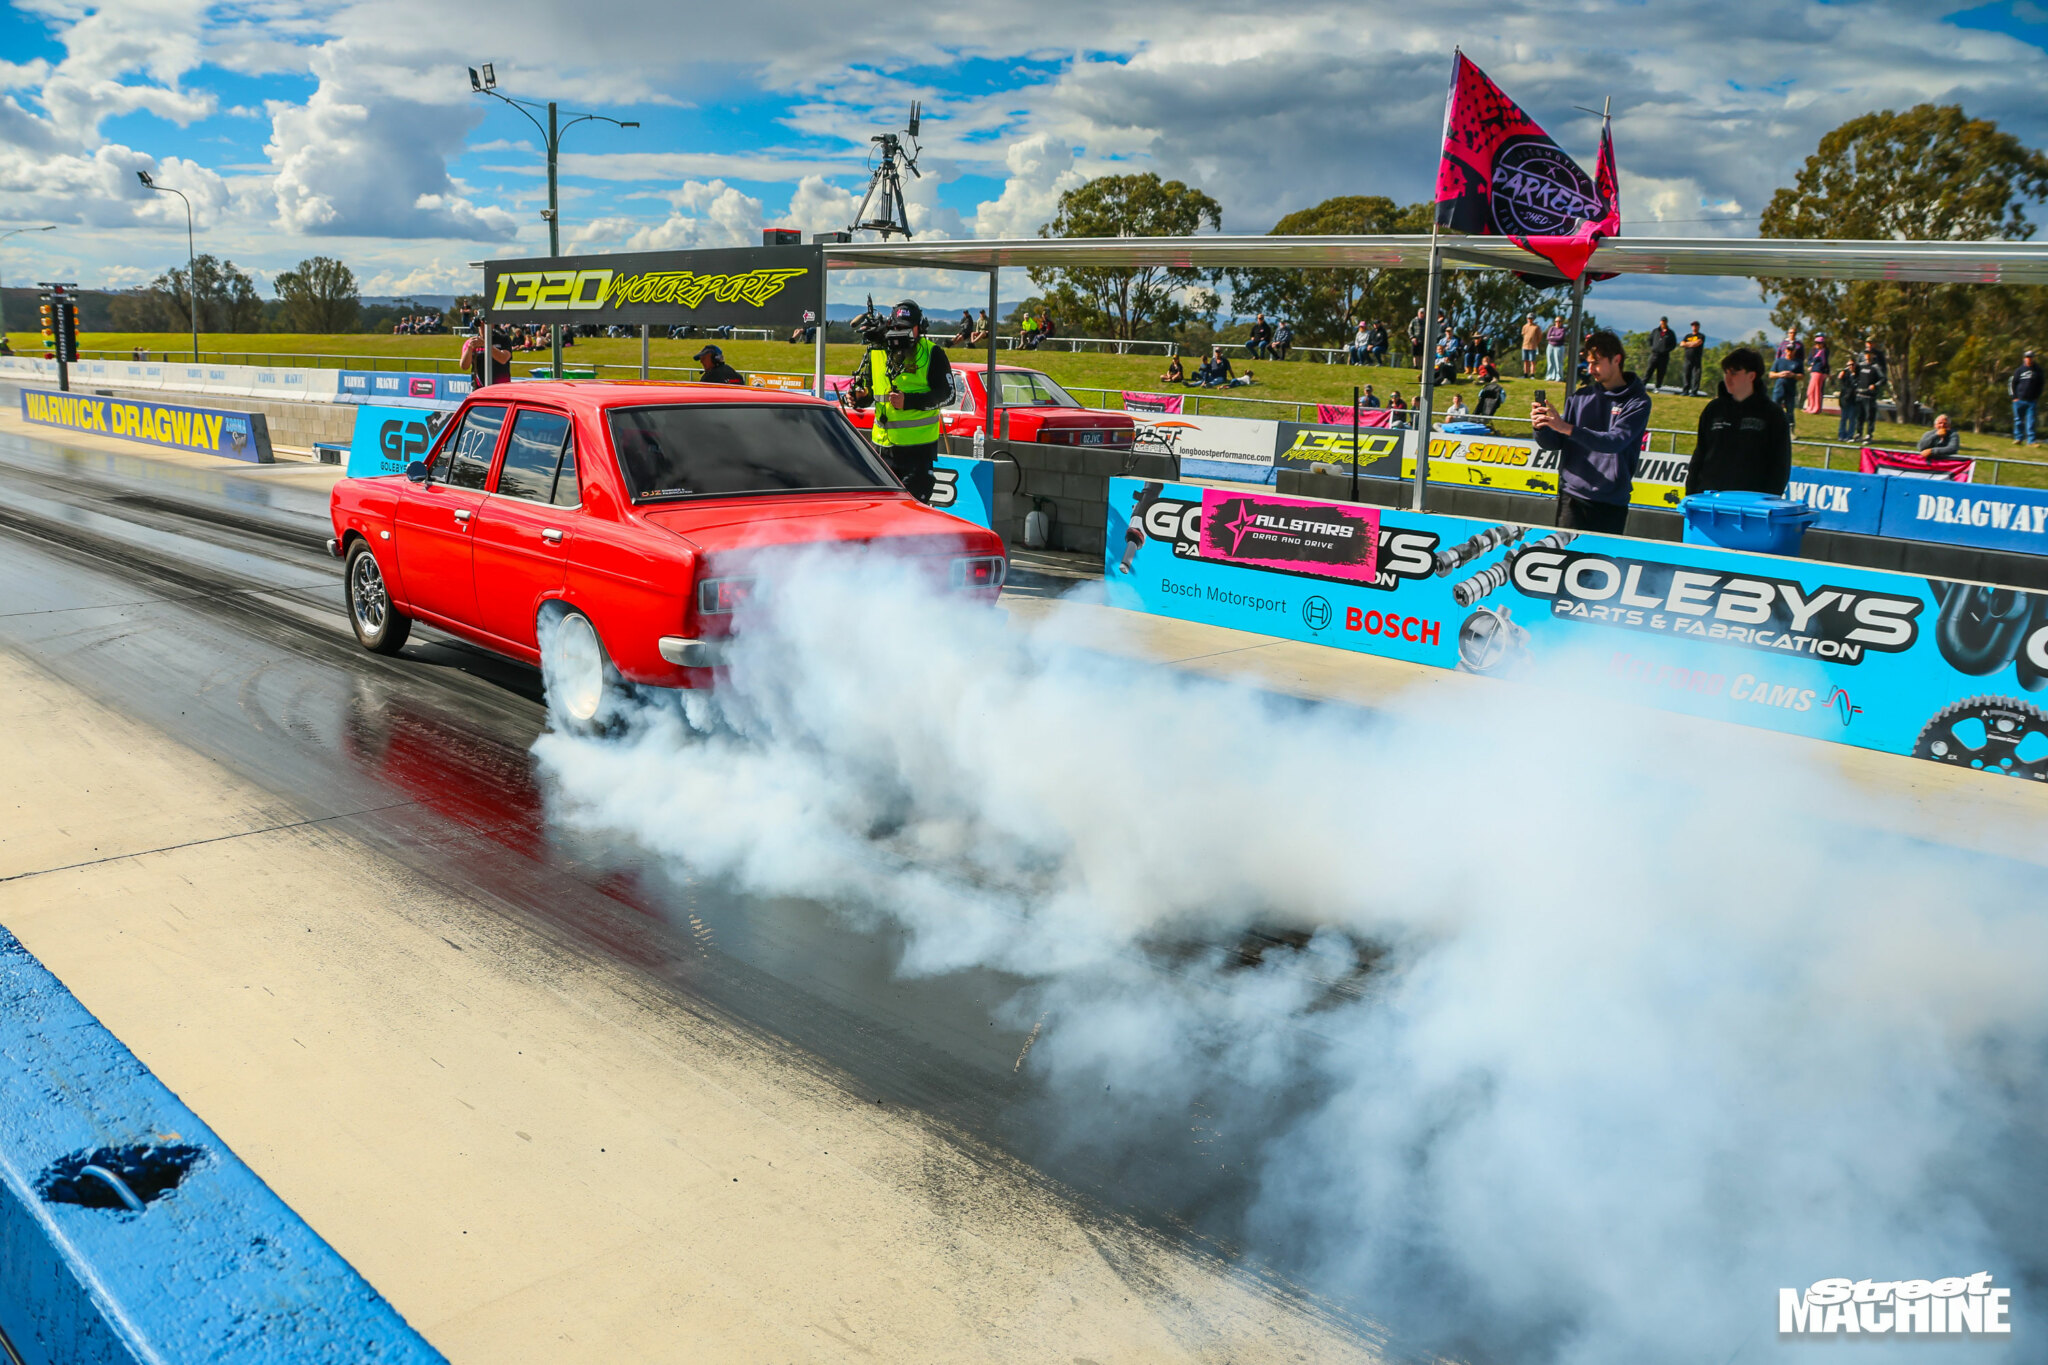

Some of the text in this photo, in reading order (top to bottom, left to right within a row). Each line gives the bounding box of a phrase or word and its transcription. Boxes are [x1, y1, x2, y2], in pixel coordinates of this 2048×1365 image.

[1491, 166, 1602, 220] PARKERS
[492, 268, 808, 311] 1320 MOTORSPORTS
[25, 392, 108, 432] WARWICK
[110, 403, 224, 451] DRAGWAY
[1179, 446, 1272, 463] longboostperformance.com
[1296, 430, 1400, 455] 1320
[1465, 442, 1532, 466] SONS
[1252, 532, 1334, 550] DRAG AND DRIVE
[1255, 514, 1354, 538] ALLSTARS
[1161, 578, 1287, 614] Bosch Motorsport
[1514, 550, 1920, 646] GOLEBY'S
[1345, 606, 1441, 646] BOSCH
[1554, 599, 1861, 661] PARTS & FABRICATION
